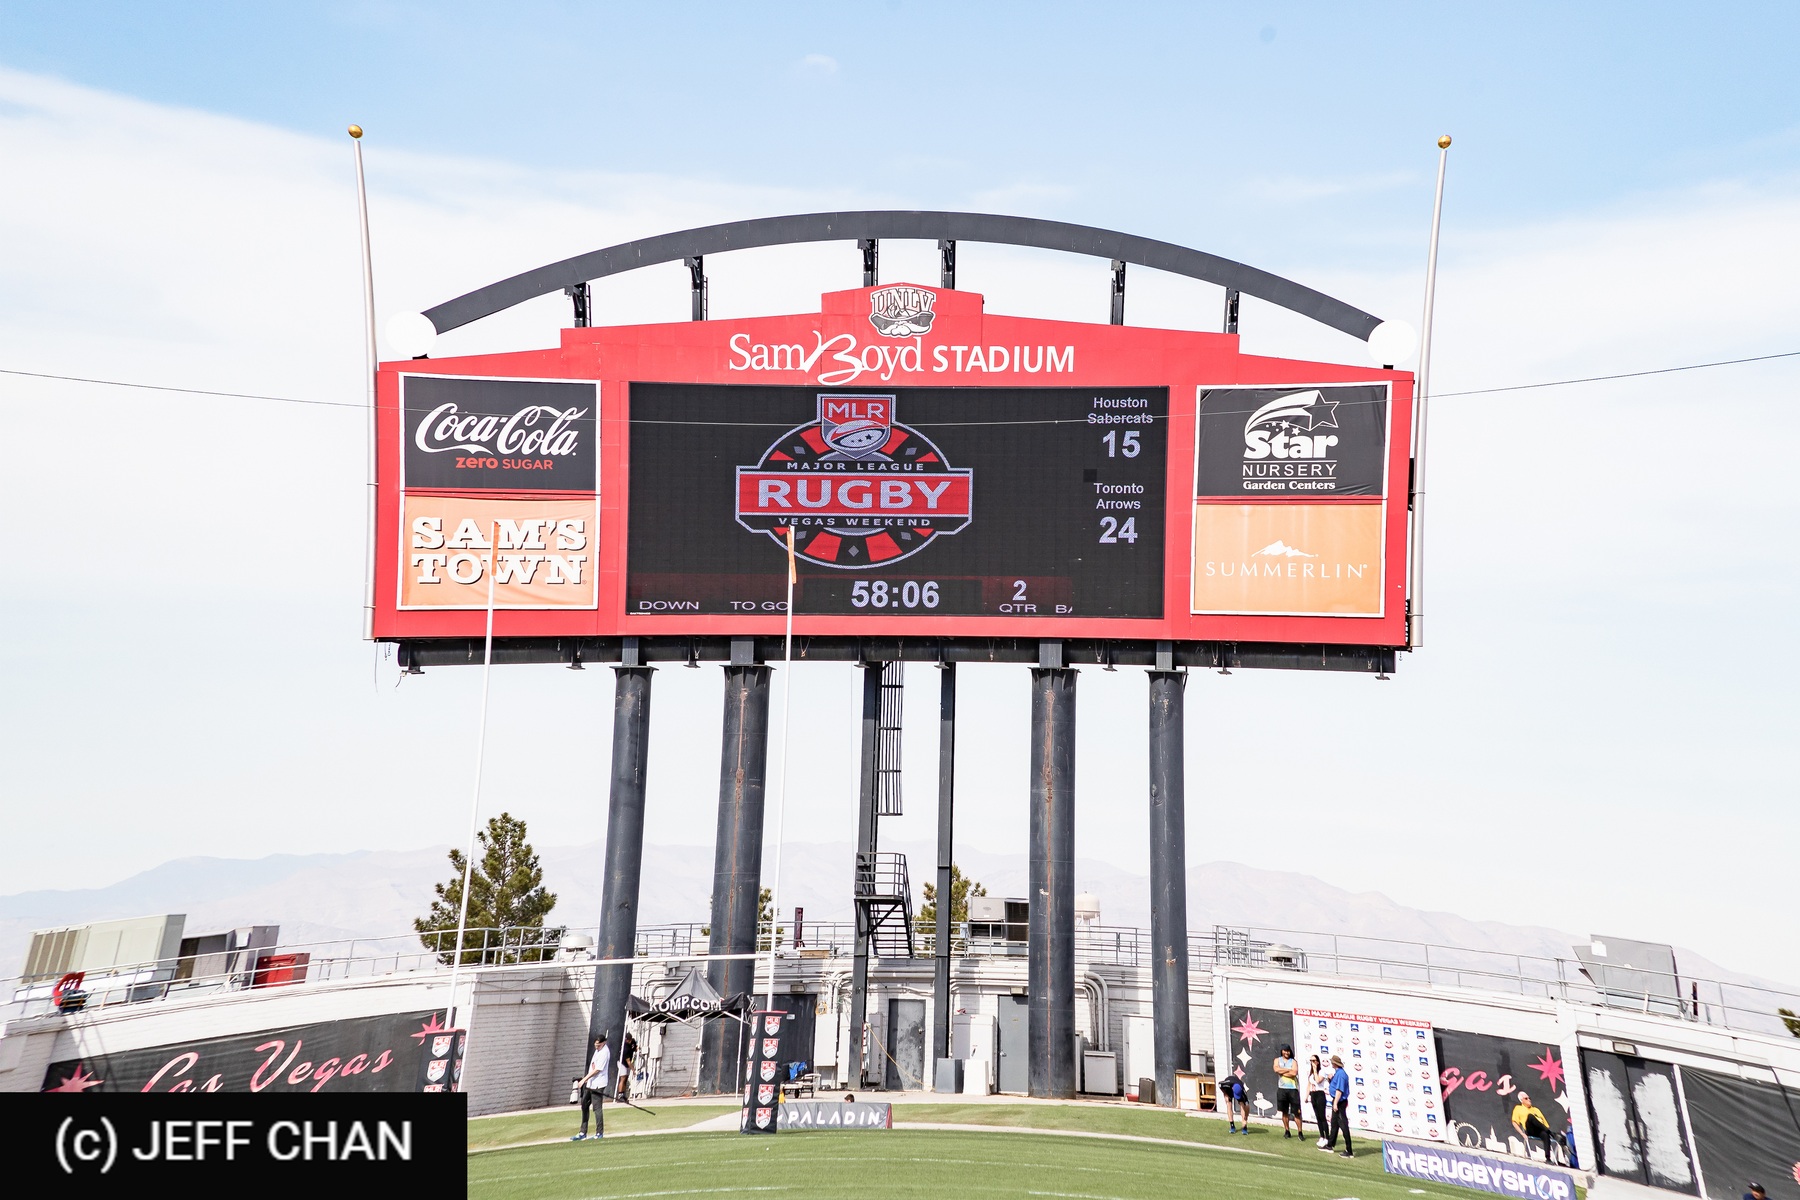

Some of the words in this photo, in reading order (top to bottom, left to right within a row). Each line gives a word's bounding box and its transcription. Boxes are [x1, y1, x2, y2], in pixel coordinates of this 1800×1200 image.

[872, 288, 935, 317] UNLV
[728, 333, 804, 371] Sam
[803, 330, 925, 387] Boyd
[932, 345, 1075, 373] STADIUM
[828, 402, 884, 419] MLR
[1093, 397, 1149, 409] Houston
[1087, 413, 1154, 425] Sabercats
[415, 402, 589, 456] Coca-Cola
[1102, 430, 1141, 458] 15
[1243, 429, 1339, 459] Star
[455, 457, 499, 469] zero
[502, 459, 554, 470] SUGAR
[786, 461, 847, 471] MAJOR
[856, 462, 925, 472] LEAGUE
[1242, 463, 1337, 477] NURSERY
[758, 479, 952, 509] RUGBY
[1093, 482, 1145, 495] Toronto
[1242, 481, 1286, 490] Garden
[1288, 481, 1336, 490] Centers
[1096, 498, 1142, 510] Arrows
[778, 517, 836, 526] VEGAS
[846, 517, 931, 527] WEEKEND
[1098, 516, 1139, 544] 24
[411, 516, 588, 551] SAM'S
[411, 553, 588, 585] TOWN
[1205, 561, 1364, 579] SUMMERLIN
[851, 580, 940, 609] 58:06
[1012, 580, 1028, 601] 2
[639, 600, 700, 611] DOWN
[729, 600, 756, 611] TO
[761, 600, 789, 611] GO
[999, 603, 1038, 614] QTR
[649, 996, 722, 1013] KOMP.COM
[1311, 1010, 1332, 1018] MAJOR
[1333, 1012, 1356, 1020] LEAGUE
[249, 1039, 395, 1092] Vegas
[1440, 1066, 1517, 1102] gas
[787, 1110, 881, 1126] PALADIN
